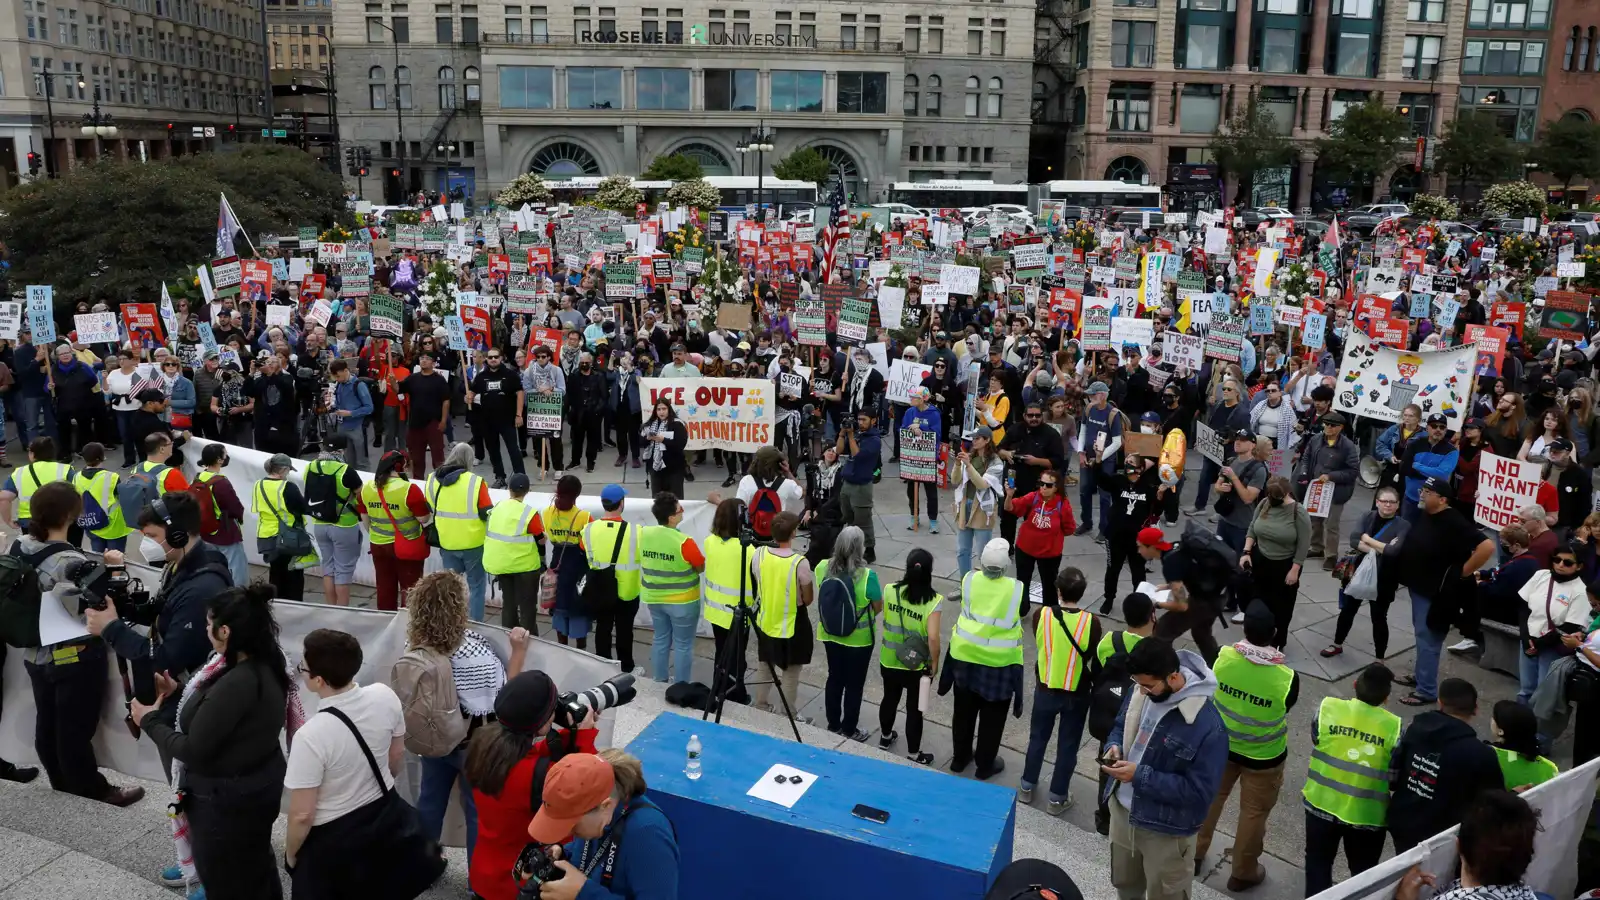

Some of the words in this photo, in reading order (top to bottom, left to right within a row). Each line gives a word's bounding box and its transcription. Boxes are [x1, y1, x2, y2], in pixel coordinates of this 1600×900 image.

[582, 30, 682, 44] ROOSEVELT
[713, 32, 812, 48] UNIVERSITY
[322, 243, 343, 252] STOP
[606, 268, 635, 276] CHICAGO
[1147, 256, 1156, 306] WELCOME
[370, 298, 402, 312] CHICAGO
[796, 300, 810, 309] STOP
[811, 300, 824, 308] THE
[842, 302, 870, 314] CHICAGO
[1193, 300, 1212, 313] FEA
[370, 309, 402, 322] PALESTINE
[904, 308, 921, 316] UCK
[76, 314, 100, 324] HANDS
[100, 314, 113, 322] OFF
[370, 318, 402, 329] OCCUPATION
[840, 314, 868, 324] PALESTINE
[1212, 314, 1228, 322] STOP
[1231, 317, 1243, 326] THE
[80, 324, 98, 332] OUR
[839, 322, 866, 332] OCCUPATION
[78, 331, 118, 344] DEMOCRACY
[1166, 332, 1202, 348] TROOPS
[1174, 346, 1189, 354] GO
[1165, 355, 1196, 368] HOME
[782, 374, 801, 386] STOP
[902, 364, 920, 384] WE
[528, 395, 562, 404] CHICAGO
[650, 388, 685, 406] ICE
[695, 386, 744, 406] OUT
[528, 407, 561, 416] PALESTINE
[686, 420, 769, 444] MMUNITIES
[921, 432, 936, 440] THE
[1496, 459, 1520, 478] NO
[1480, 469, 1538, 496] TYRANT
[1487, 494, 1522, 510] -NO-
[1476, 503, 1520, 526] TROOP
[642, 550, 658, 559] SAFETY
[660, 552, 674, 562] TEAM
[906, 610, 923, 622] TEAM
[1218, 682, 1248, 701] SAFETY
[1249, 694, 1272, 708] TEAM
[1328, 725, 1359, 740] SAFETY
[1360, 731, 1385, 747] TEAM
[606, 842, 616, 872] SONY
